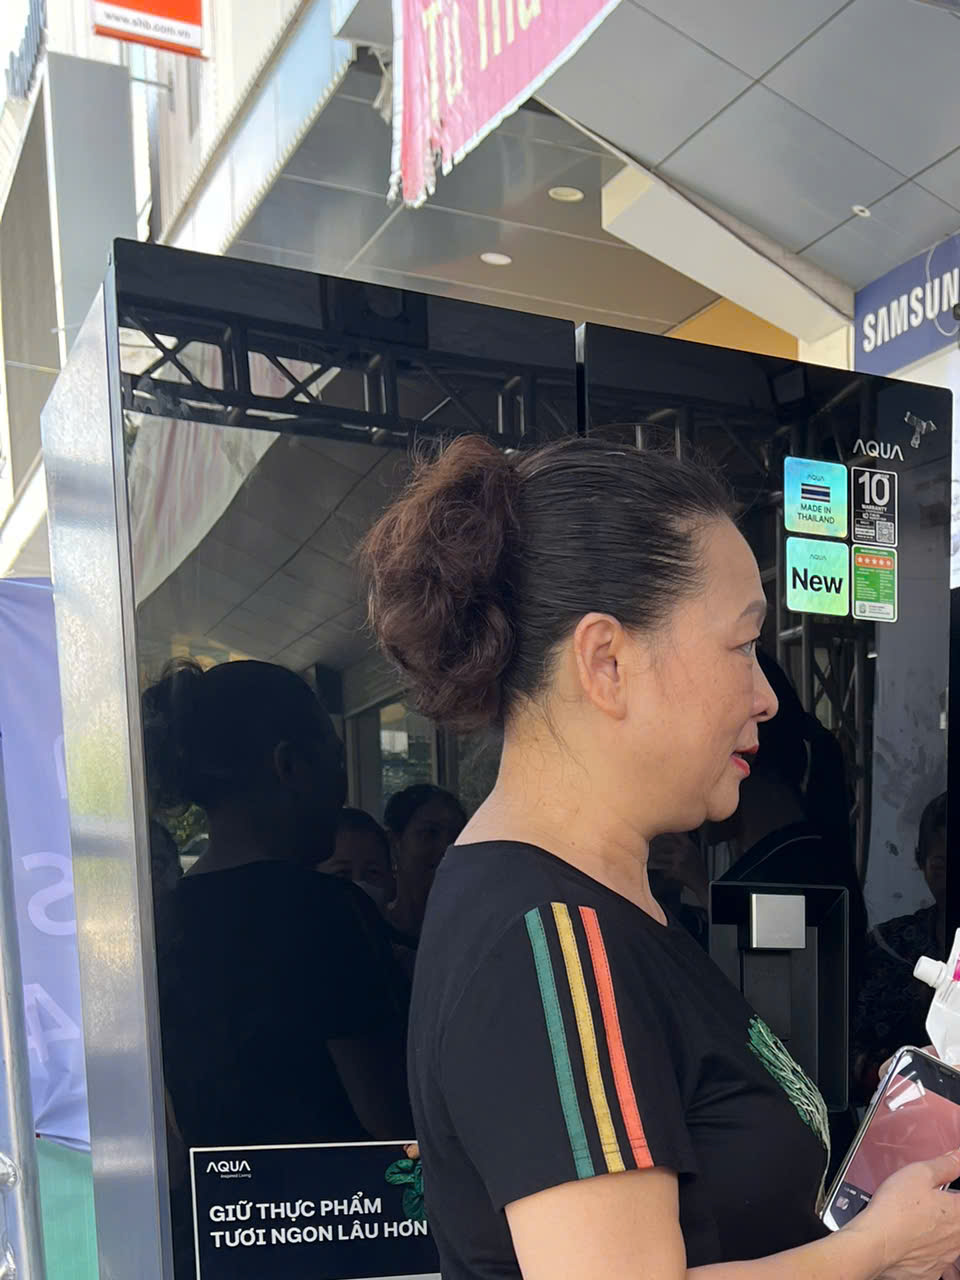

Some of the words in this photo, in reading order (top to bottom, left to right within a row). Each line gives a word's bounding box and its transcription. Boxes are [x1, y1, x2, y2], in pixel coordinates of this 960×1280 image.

[853, 438, 905, 461] AQUA
[858, 471, 891, 506] 10
[797, 513, 836, 525] THAILAND
[800, 503, 823, 514] MADE
[823, 505, 832, 515] IN
[791, 567, 844, 595] New
[206, 1160, 251, 1173] AQUA
[209, 1200, 253, 1222] GIỮ
[256, 1200, 316, 1222] THỰC
[320, 1191, 382, 1217] PHẨM
[210, 1228, 267, 1248] TƯƠI
[271, 1224, 333, 1245] NGON
[338, 1219, 379, 1240] LÂU
[384, 1218, 428, 1238] HƠN
